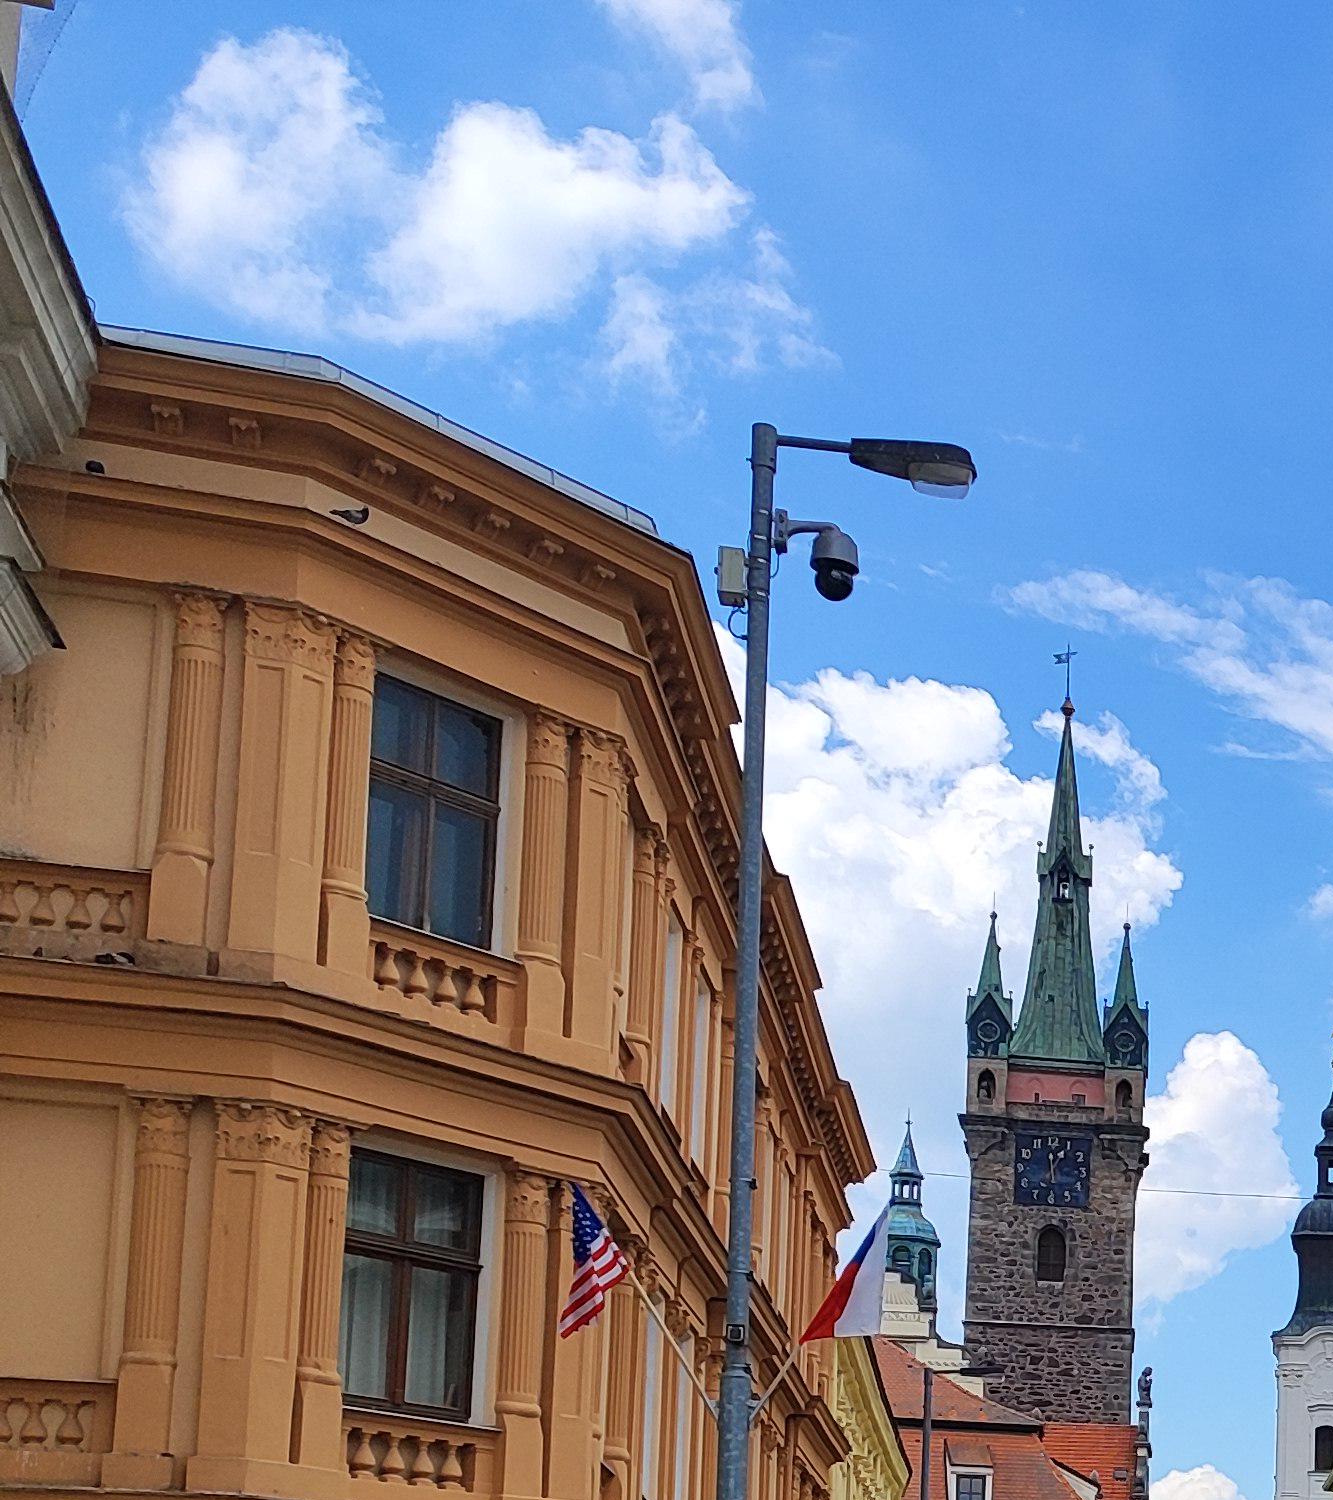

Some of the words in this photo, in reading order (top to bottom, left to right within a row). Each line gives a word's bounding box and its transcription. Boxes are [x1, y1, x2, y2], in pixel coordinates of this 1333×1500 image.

[1033, 1139, 1041, 1148] 11
[1048, 1137, 1059, 1146] 12
[1067, 1141, 1071, 1150] 1
[1021, 1149, 1031, 1159] 10
[1076, 1152, 1084, 1162] 2
[1017, 1163, 1024, 1172] 9
[1079, 1168, 1087, 1178] 3
[1021, 1178, 1028, 1187] 8
[1074, 1181, 1081, 1191] 4
[1032, 1190, 1039, 1199] 7
[1048, 1190, 1054, 1204] 6
[1064, 1191, 1071, 1202] 5
